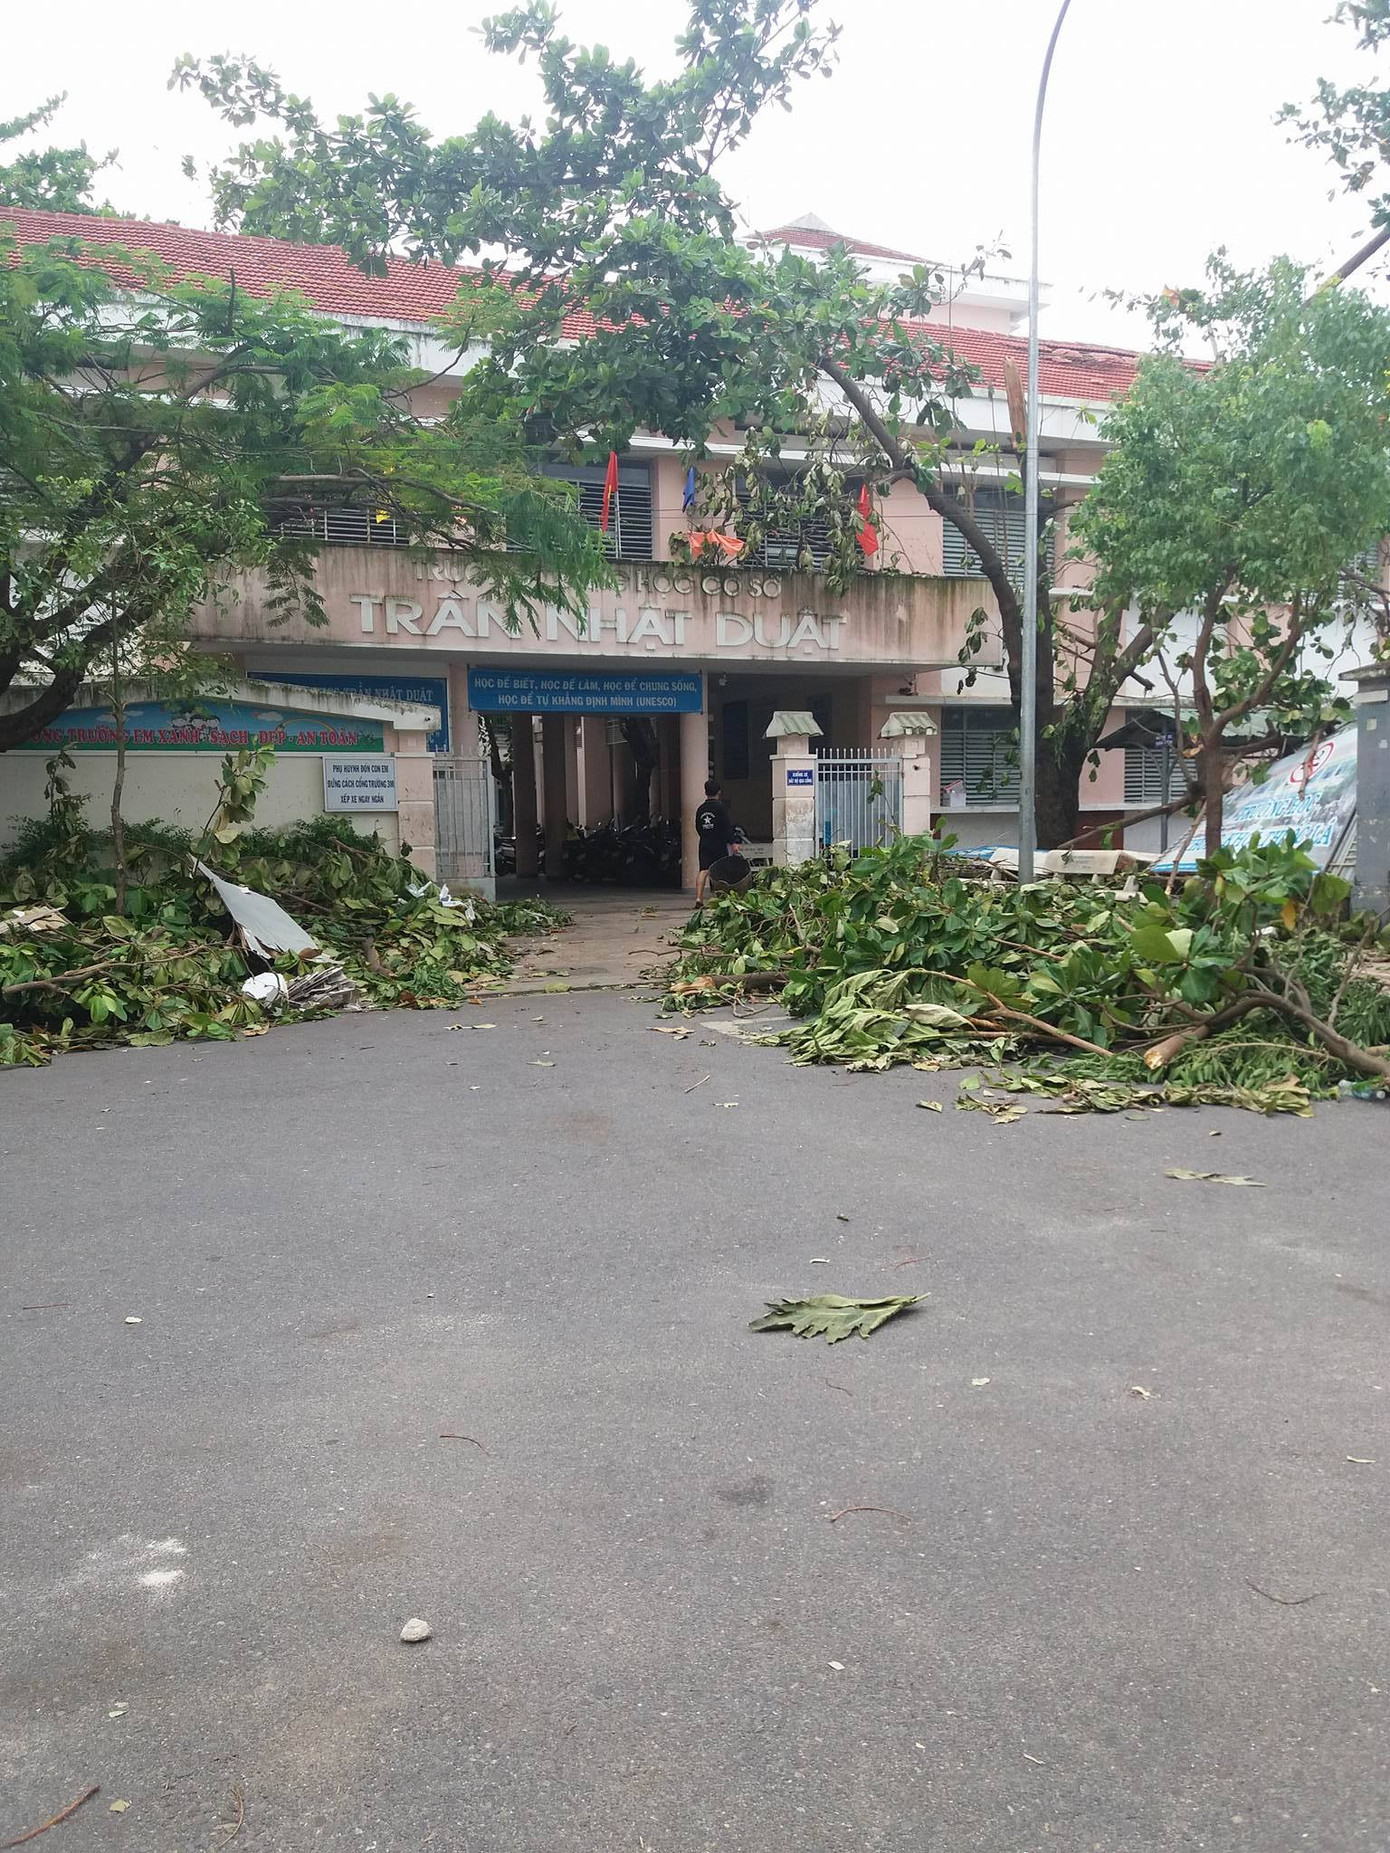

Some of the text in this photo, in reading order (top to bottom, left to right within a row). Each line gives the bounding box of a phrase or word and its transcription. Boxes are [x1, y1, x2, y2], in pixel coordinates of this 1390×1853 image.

[350, 590, 847, 654] TRẦN NHẬT DUẬT
[475, 678, 494, 690] HỌC
[497, 676, 510, 688] ĐỂ
[541, 680, 560, 691] HỌC
[563, 677, 575, 690] ĐỂ
[603, 681, 622, 692] HỌC
[625, 677, 637, 691] ĐỂ
[639, 681, 669, 691] CHUNG
[498, 695, 518, 706] HỌC
[520, 691, 533, 705] ĐỂ
[536, 695, 549, 706] TỰ
[586, 697, 608, 708] ĐỊNH
[610, 695, 633, 707] MÌNH
[636, 696, 677, 707] (UNESCO)
[133, 729, 155, 744] EM
[209, 729, 249, 746] SẠCH
[296, 730, 317, 745] AN
[319, 727, 358, 745] TOÀN
[371, 764, 380, 773] CON
[381, 764, 388, 773] EM
[342, 777, 354, 788] CÁCH
